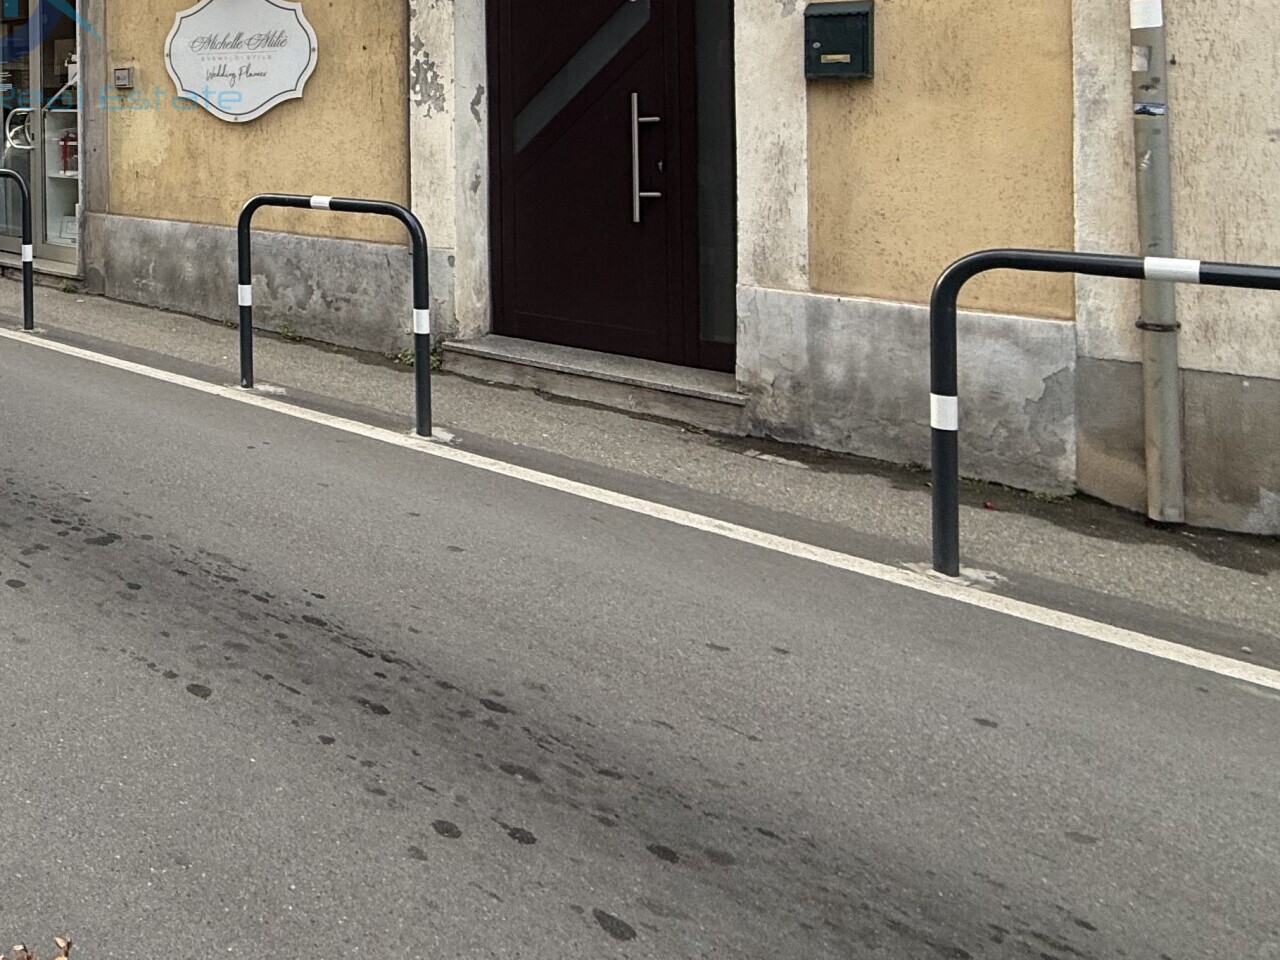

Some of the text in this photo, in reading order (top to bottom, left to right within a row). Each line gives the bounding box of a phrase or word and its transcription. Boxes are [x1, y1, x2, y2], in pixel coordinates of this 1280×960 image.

[188, 32, 244, 52] Michelle
[206, 63, 267, 87] Wedding Planner
